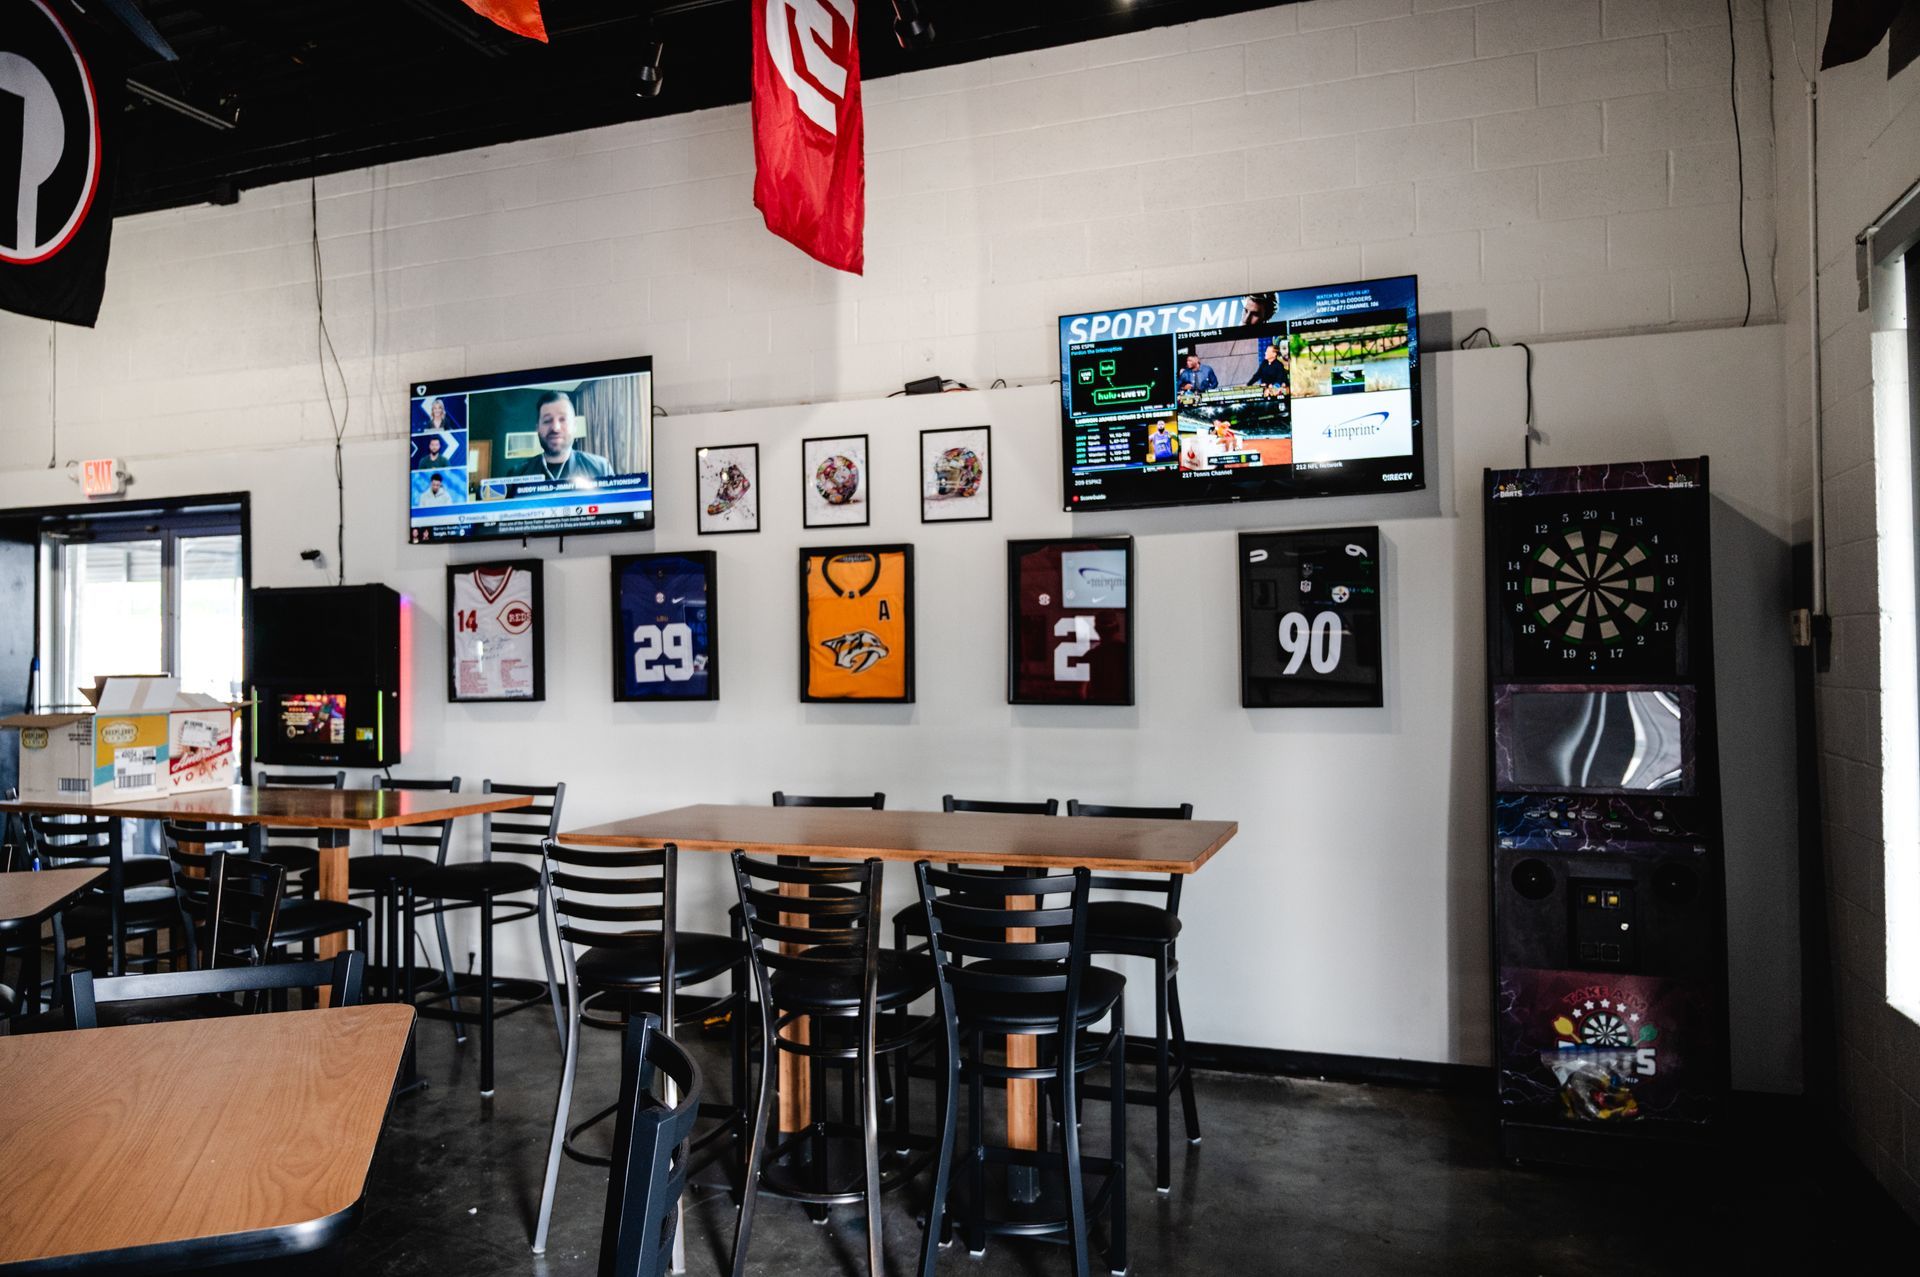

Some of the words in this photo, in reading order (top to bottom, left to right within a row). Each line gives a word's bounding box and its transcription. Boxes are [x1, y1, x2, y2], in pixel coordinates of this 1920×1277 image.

[1316, 317, 1338, 325] Channel
[85, 461, 112, 491] EXIT
[1382, 472, 1413, 482] DIRECTV
[1562, 514, 1569, 523] 5
[1583, 510, 1598, 519] 20
[1611, 512, 1615, 520] 1
[1630, 517, 1643, 526] 18
[1535, 525, 1548, 534] 12
[1651, 535, 1659, 544] 4
[1522, 545, 1530, 554] 9
[1664, 555, 1678, 564] 13
[1508, 561, 1520, 570] 14
[1506, 582, 1518, 590] 11
[1667, 577, 1675, 586] 6
[1516, 603, 1523, 612] 8
[1664, 600, 1677, 609] 10
[879, 600, 891, 621] A
[458, 610, 478, 632] 14
[1522, 624, 1536, 634] 16
[1655, 623, 1668, 632] 15
[1278, 610, 1342, 674] 90
[1544, 640, 1550, 649] 7
[1637, 636, 1645, 645] 2
[634, 623, 694, 683] 29
[1054, 617, 1090, 682] 2
[1562, 650, 1576, 658] 19
[1610, 649, 1623, 658] 17
[1590, 652, 1597, 661] 3
[174, 758, 229, 786] VODKA
[1562, 986, 1609, 1004] TAKE
